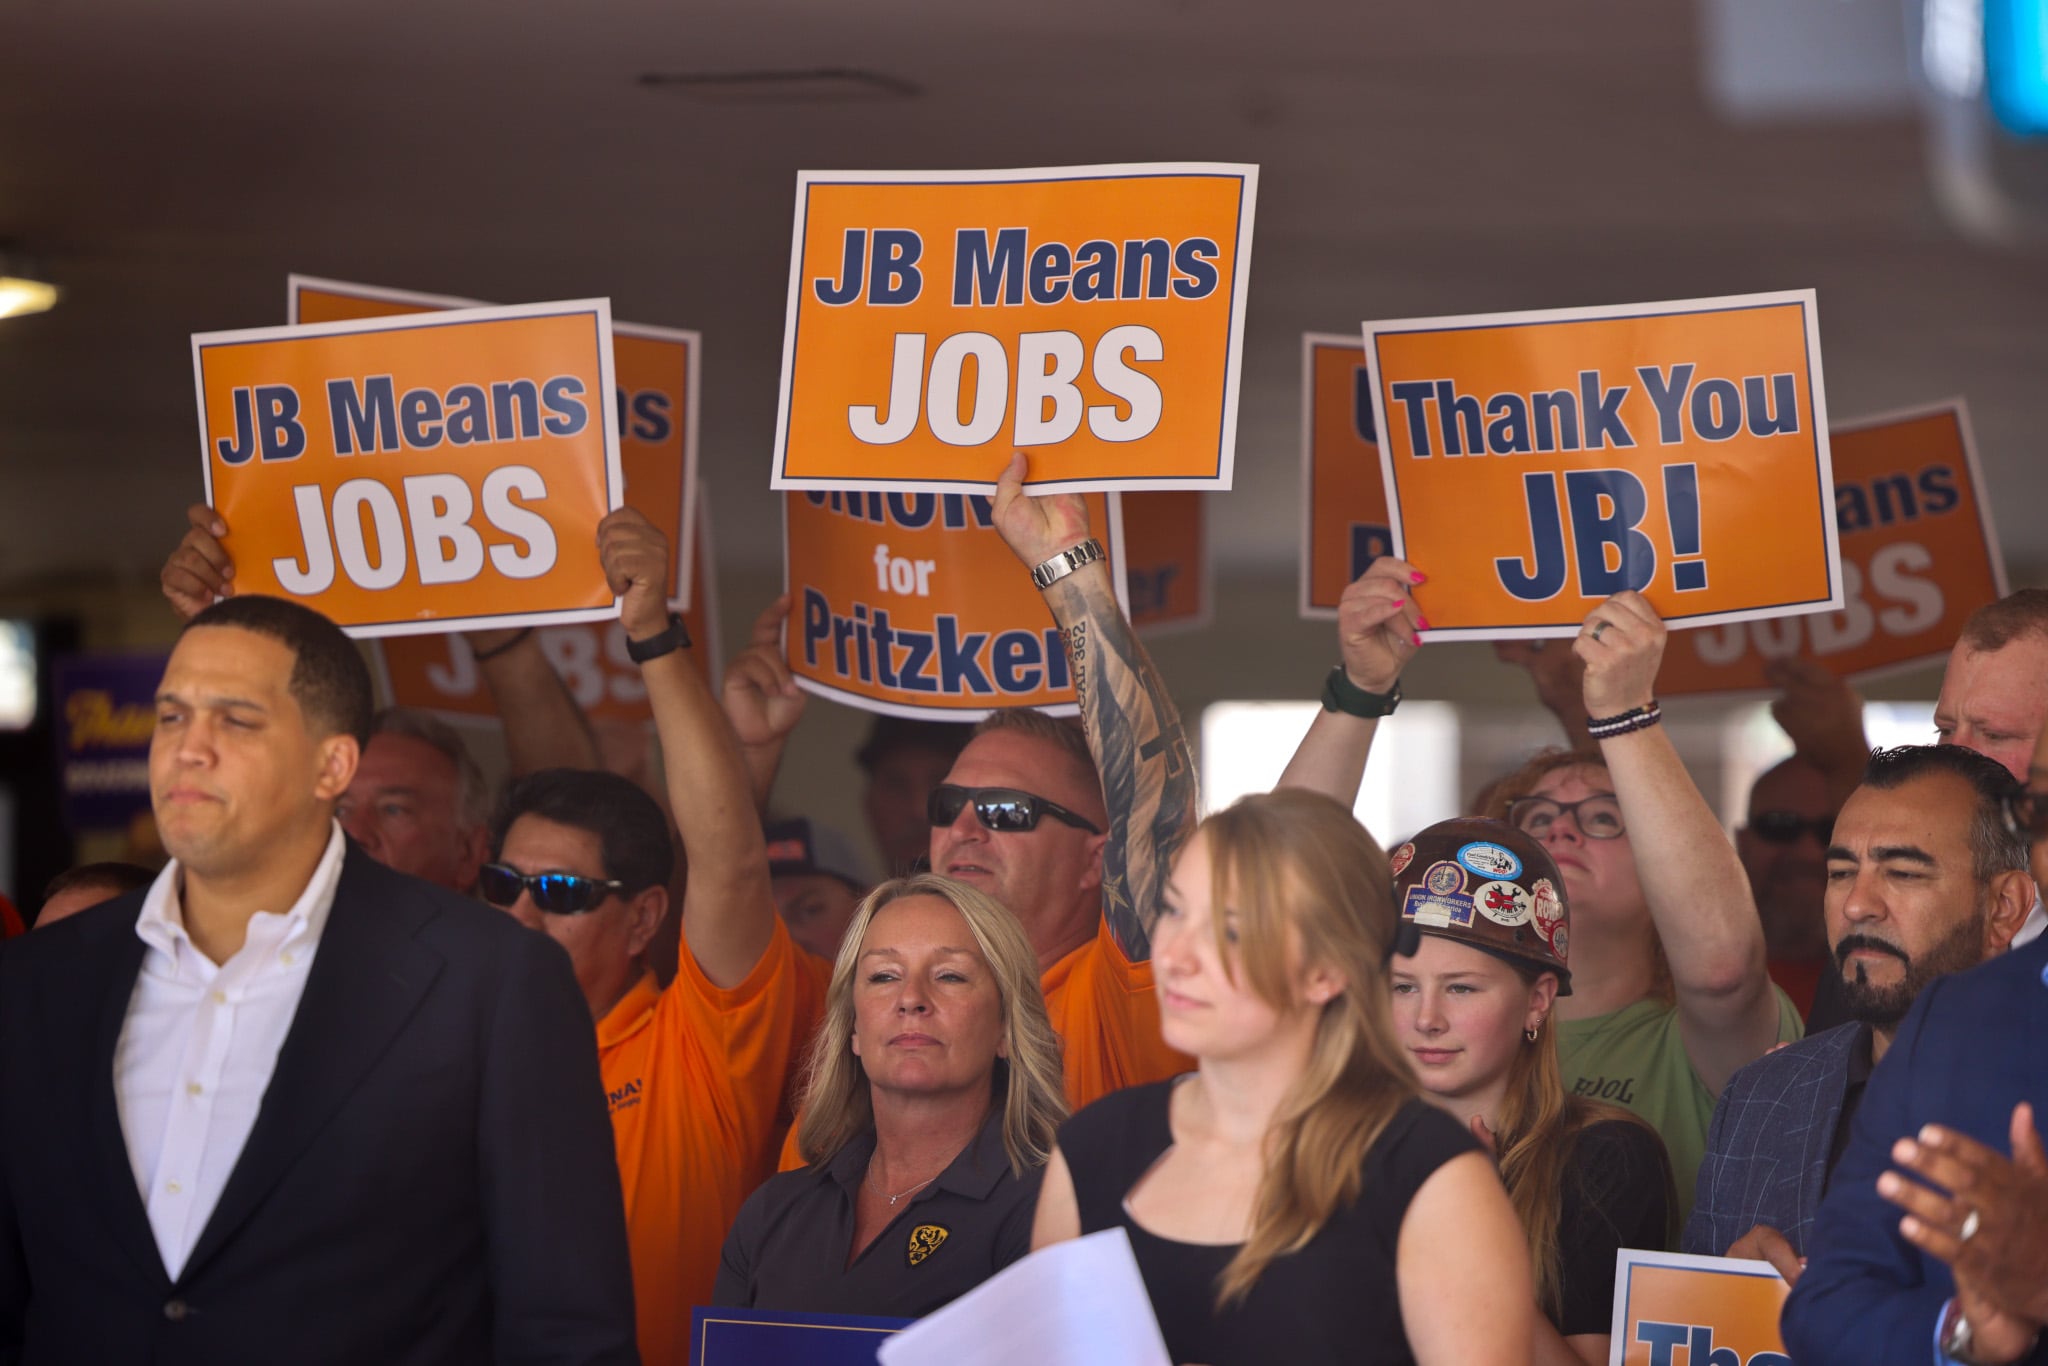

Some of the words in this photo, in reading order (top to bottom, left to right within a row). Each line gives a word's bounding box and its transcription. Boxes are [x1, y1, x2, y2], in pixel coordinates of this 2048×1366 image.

[814, 227, 924, 307] JB
[951, 226, 1221, 308] Means
[217, 383, 306, 467] JB
[325, 373, 589, 457] Means
[847, 324, 1165, 448] JOBS
[1390, 369, 1636, 458] Thank
[1636, 362, 1799, 446] You
[271, 464, 559, 596] JOBS
[1493, 461, 1709, 602] JB!
[1834, 463, 1961, 534] ans
[873, 543, 936, 597] for
[1072, 620, 1087, 661] 362
